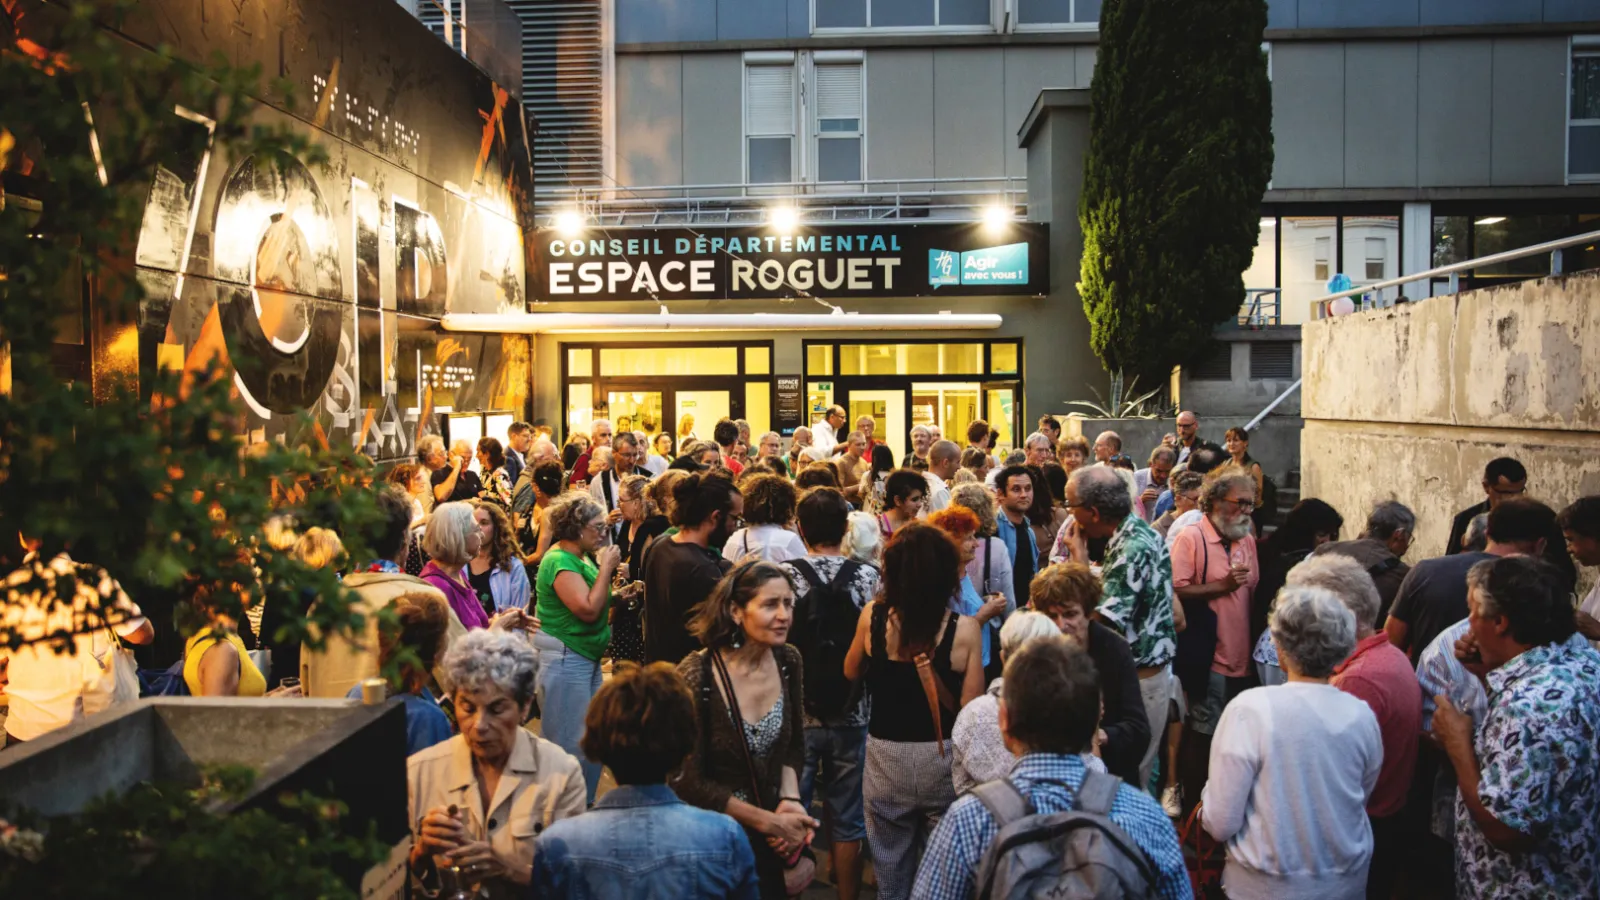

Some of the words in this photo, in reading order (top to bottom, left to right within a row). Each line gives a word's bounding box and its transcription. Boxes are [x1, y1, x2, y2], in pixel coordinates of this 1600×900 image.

[549, 238, 664, 257] CONSEIL
[675, 234, 902, 255] DÉPARTEMENTAL
[964, 255, 999, 271] Agir
[549, 260, 716, 294] ESPACE
[732, 257, 901, 291] ROGUET
[964, 272, 989, 280] avec
[991, 272, 1017, 280] vous
